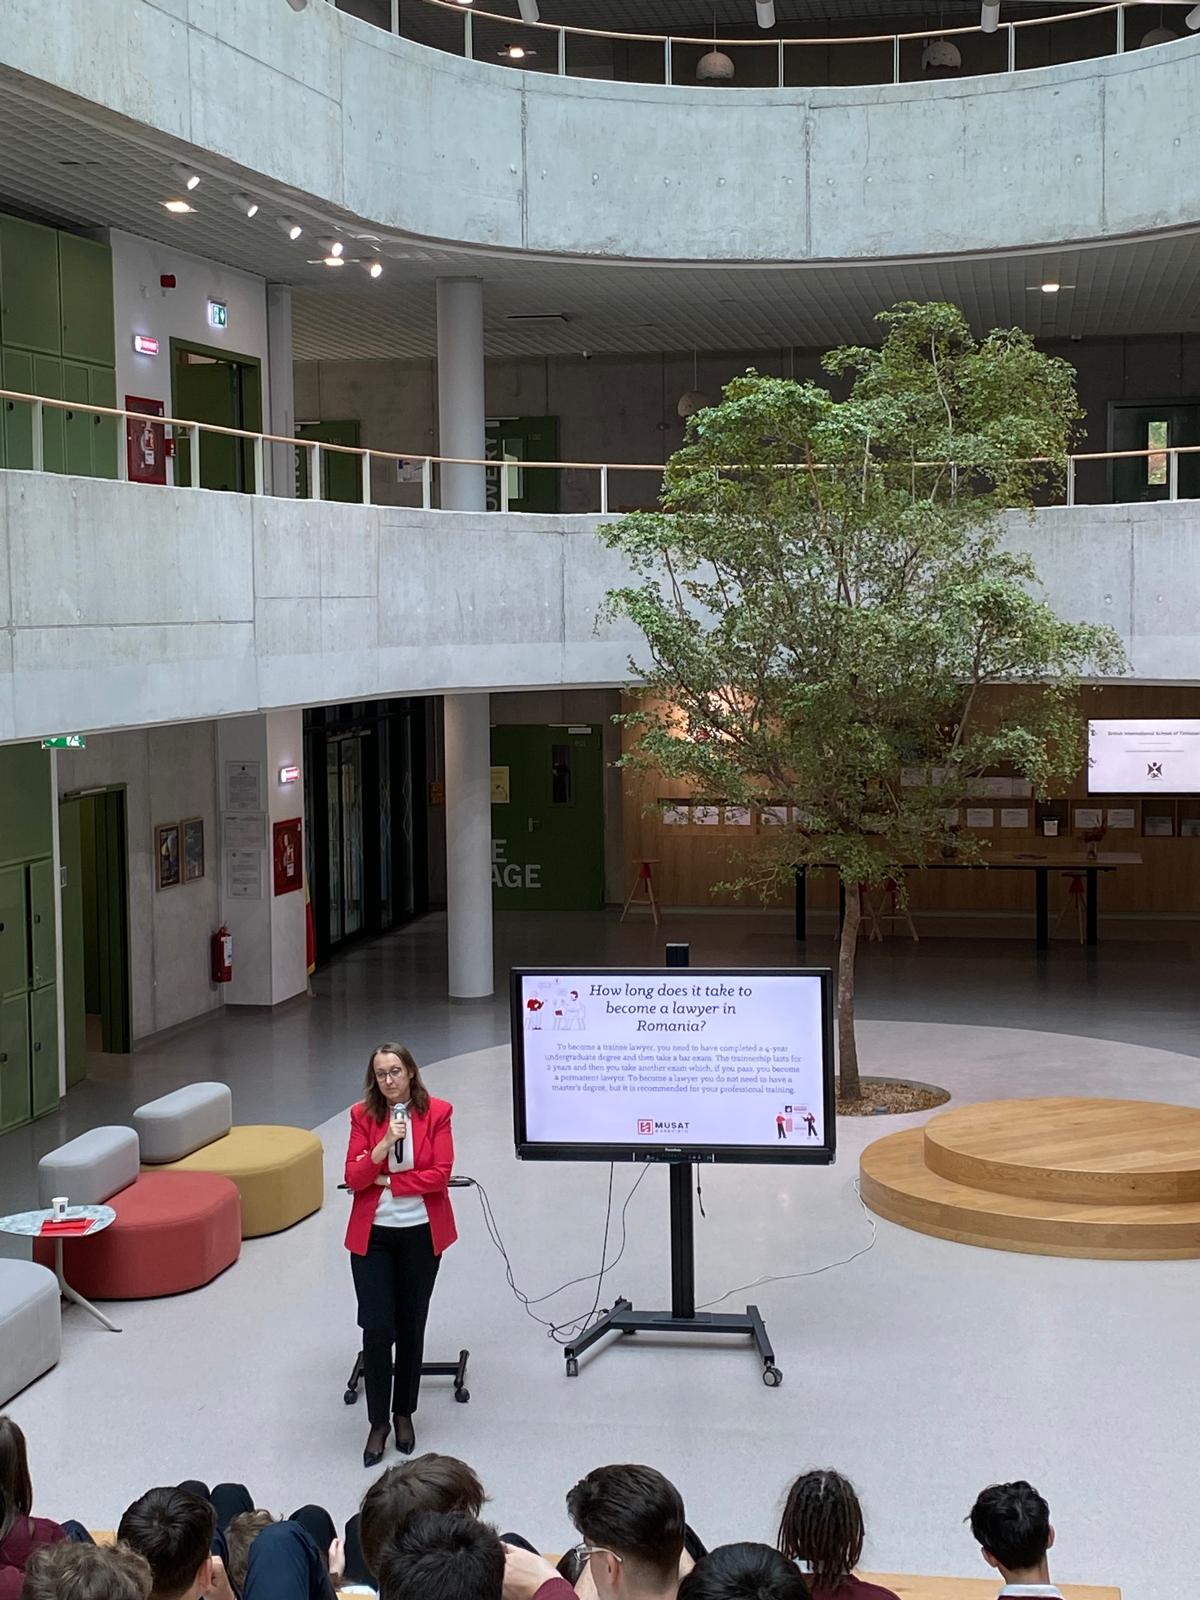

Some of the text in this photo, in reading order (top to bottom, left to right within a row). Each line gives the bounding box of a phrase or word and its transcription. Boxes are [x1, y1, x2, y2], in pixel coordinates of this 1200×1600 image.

[589, 984, 752, 1000] How long does it take to
[606, 1001, 736, 1017] become a lawyer in
[636, 1020, 706, 1032] Romania?
[720, 1044, 757, 1053] completed
[544, 1053, 596, 1062] undergraduate
[598, 1053, 621, 1062] degree
[674, 1074, 698, 1083] lawyer
[720, 1085, 763, 1094] professional
